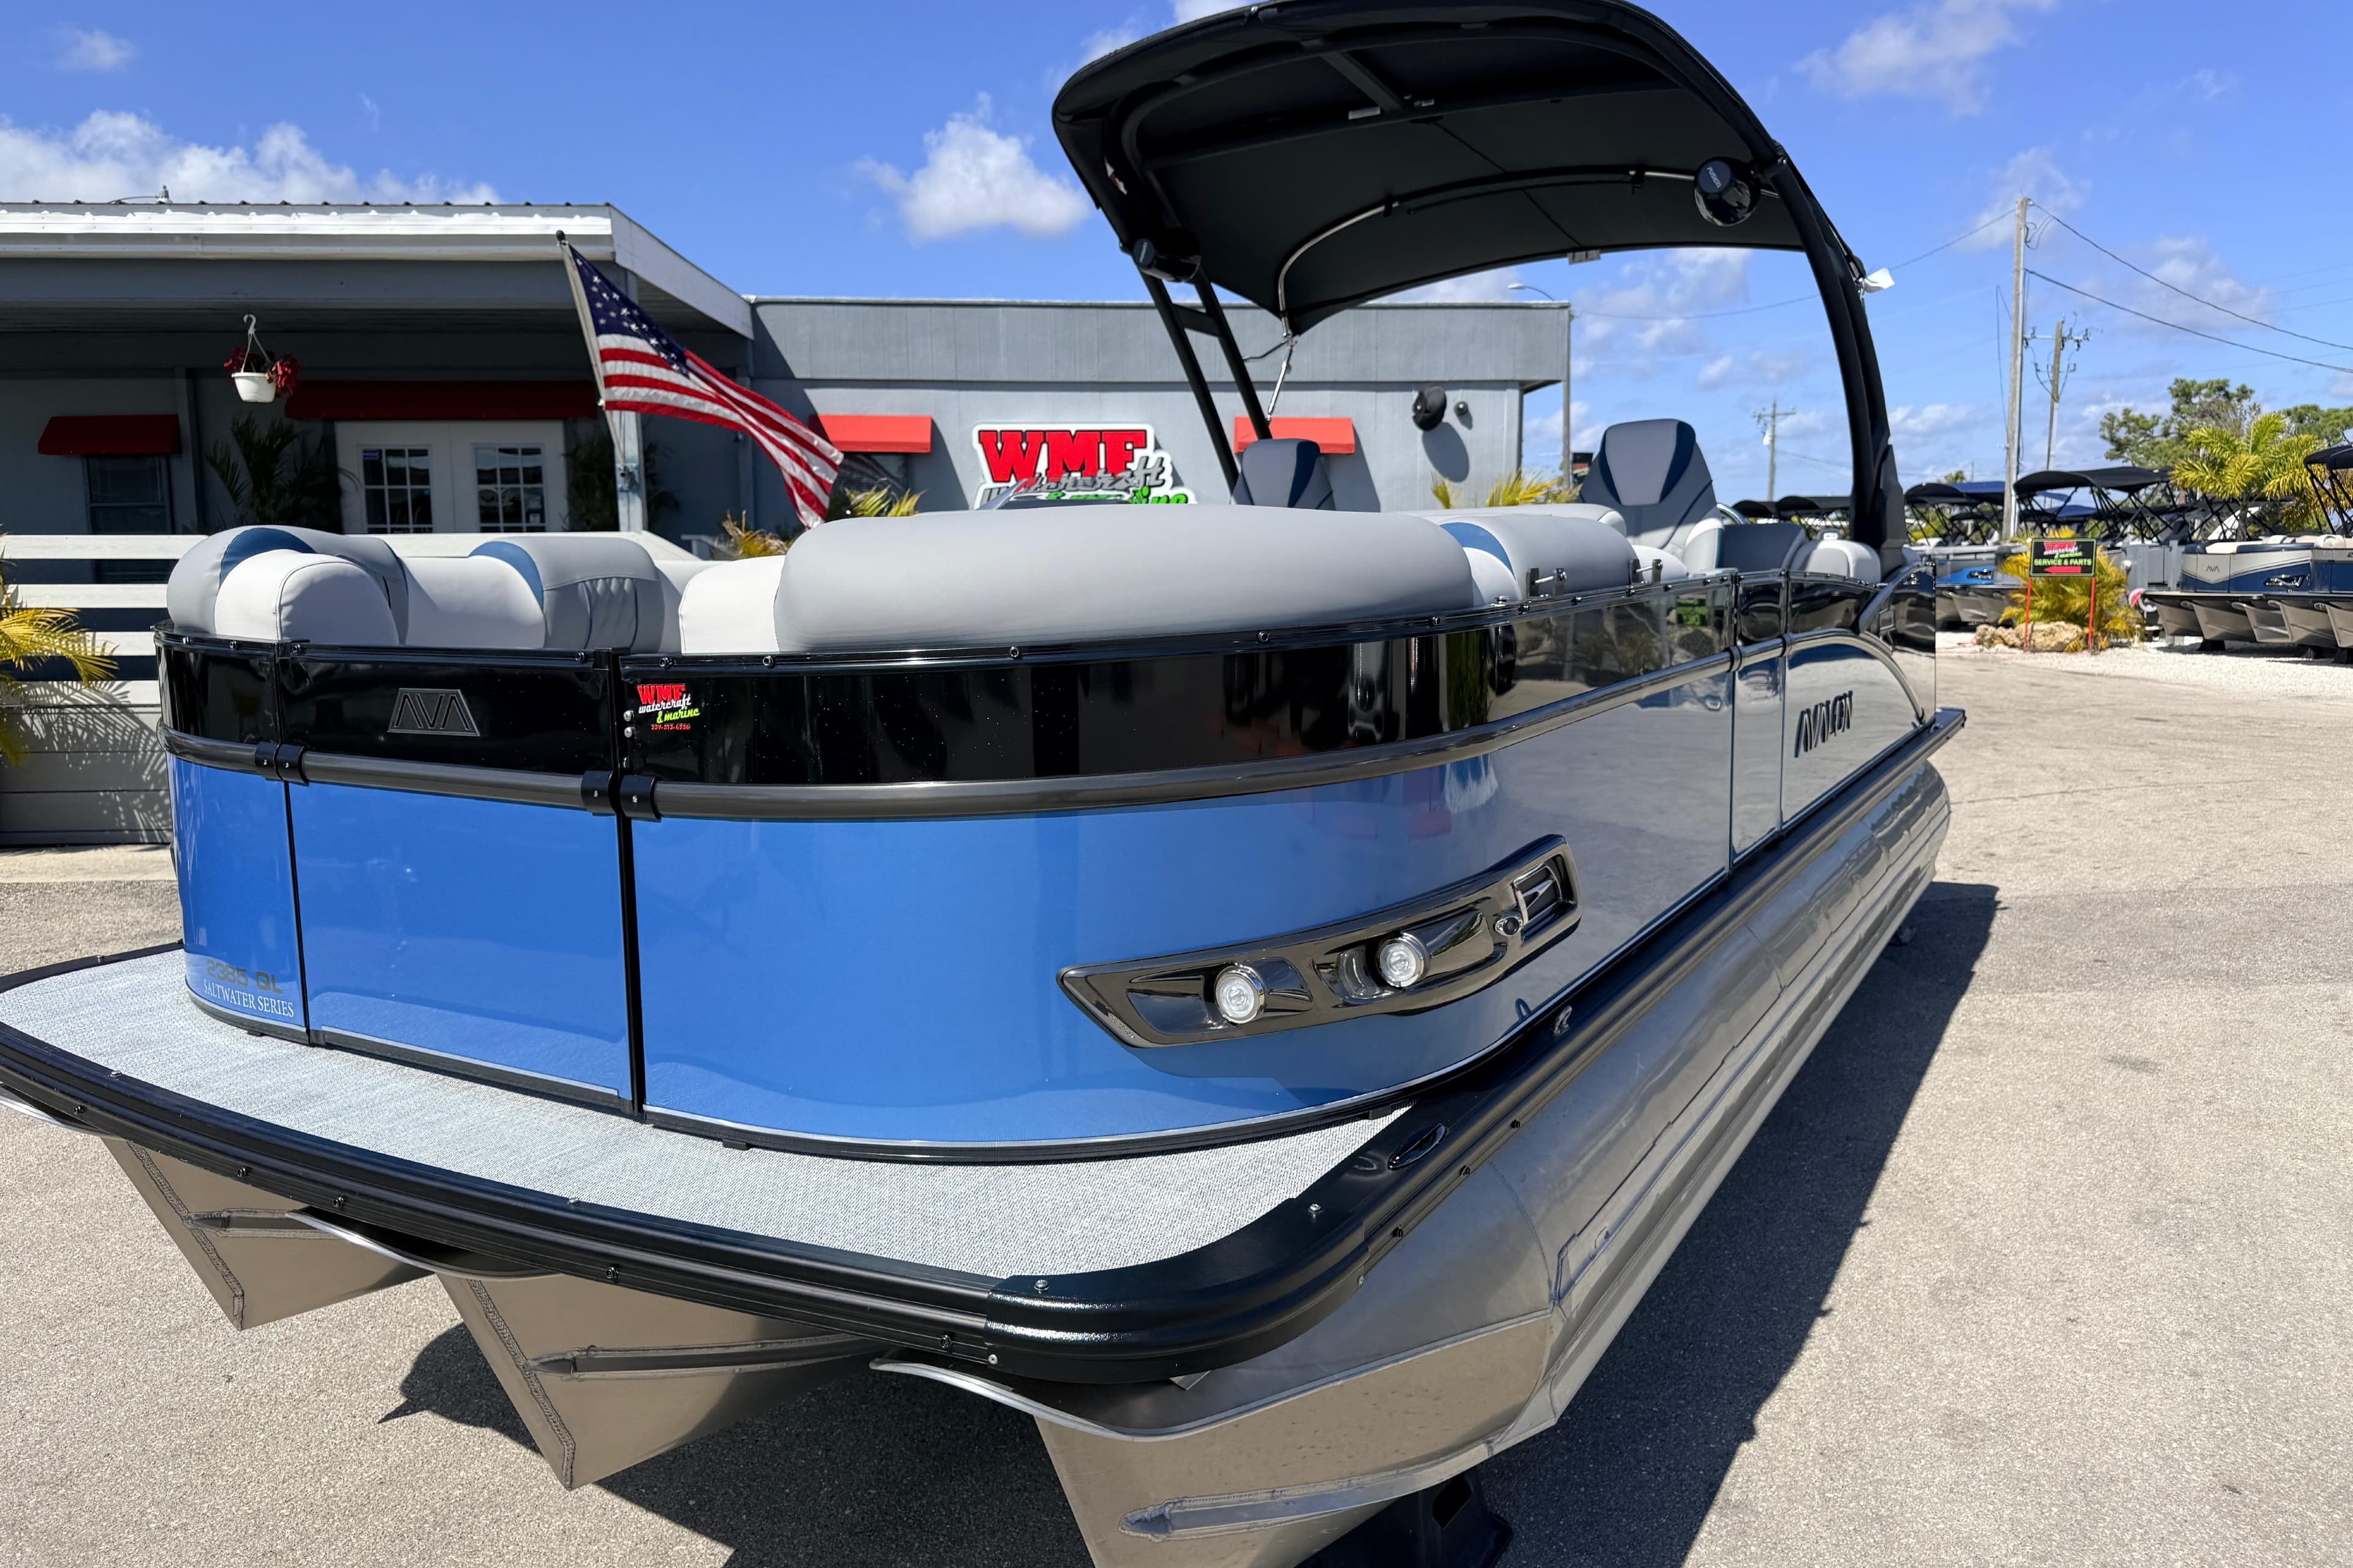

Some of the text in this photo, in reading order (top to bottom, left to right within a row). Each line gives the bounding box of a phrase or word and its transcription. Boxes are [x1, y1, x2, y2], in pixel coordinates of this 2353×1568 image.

[978, 430, 1147, 483] WMF
[637, 683, 687, 705] WMF
[638, 693, 692, 714] watercraft
[656, 706, 701, 724] & marine
[207, 959, 284, 994] 2385 QL
[203, 979, 295, 1018] SALTWATER SERIES
